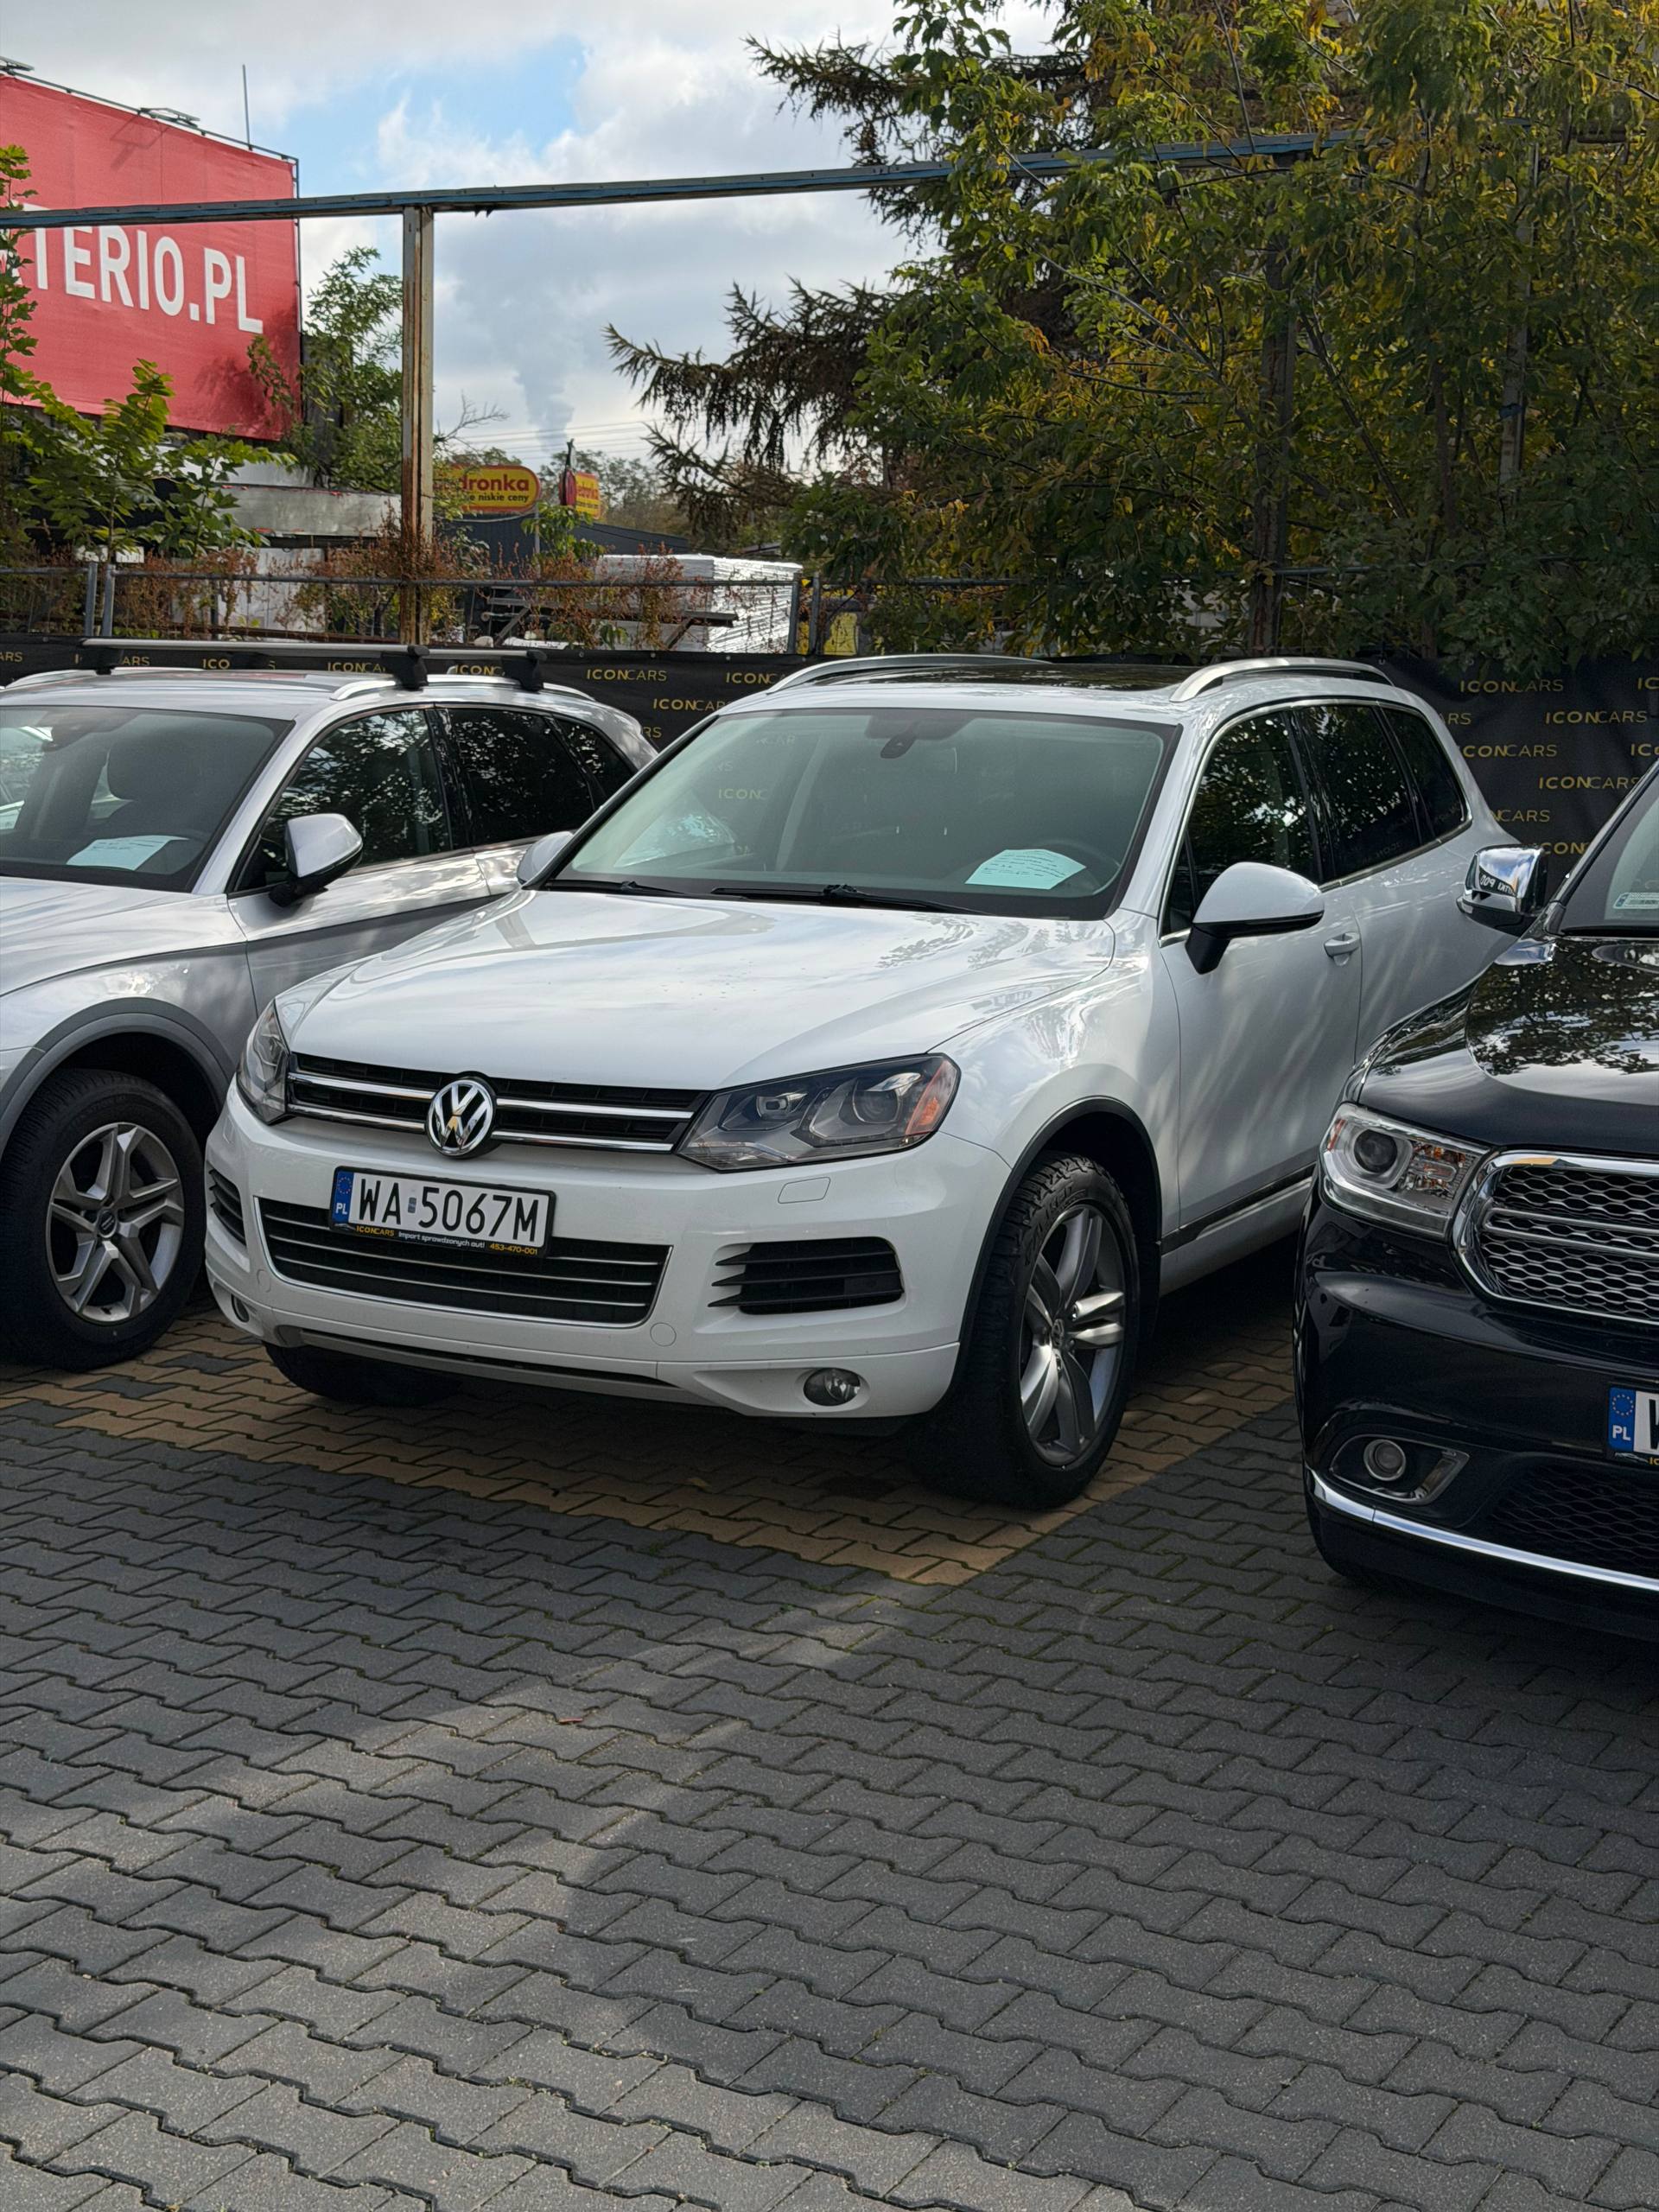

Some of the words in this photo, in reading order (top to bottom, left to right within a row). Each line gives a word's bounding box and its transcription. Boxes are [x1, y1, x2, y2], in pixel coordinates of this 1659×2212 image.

[507, 494, 529, 503] ceny
[327, 662, 386, 673] ICONCA
[455, 664, 505, 677] ICONC
[587, 669, 667, 682] ICONCARS
[726, 672, 785, 684] ICONC
[1460, 678, 1564, 693] ICONCARS
[653, 698, 728, 711] ICONCAR
[1545, 710, 1647, 724] ICONCARS
[1462, 744, 1558, 758] CONCARS
[1490, 809, 1551, 823] NCARS
[335, 1202, 348, 1216] PL
[358, 1178, 402, 1225] WA
[418, 1186, 539, 1243] 5067M
[356, 1225, 395, 1237] ICONCARS
[398, 1230, 421, 1241] Import
[1612, 1424, 1631, 1441] PL
